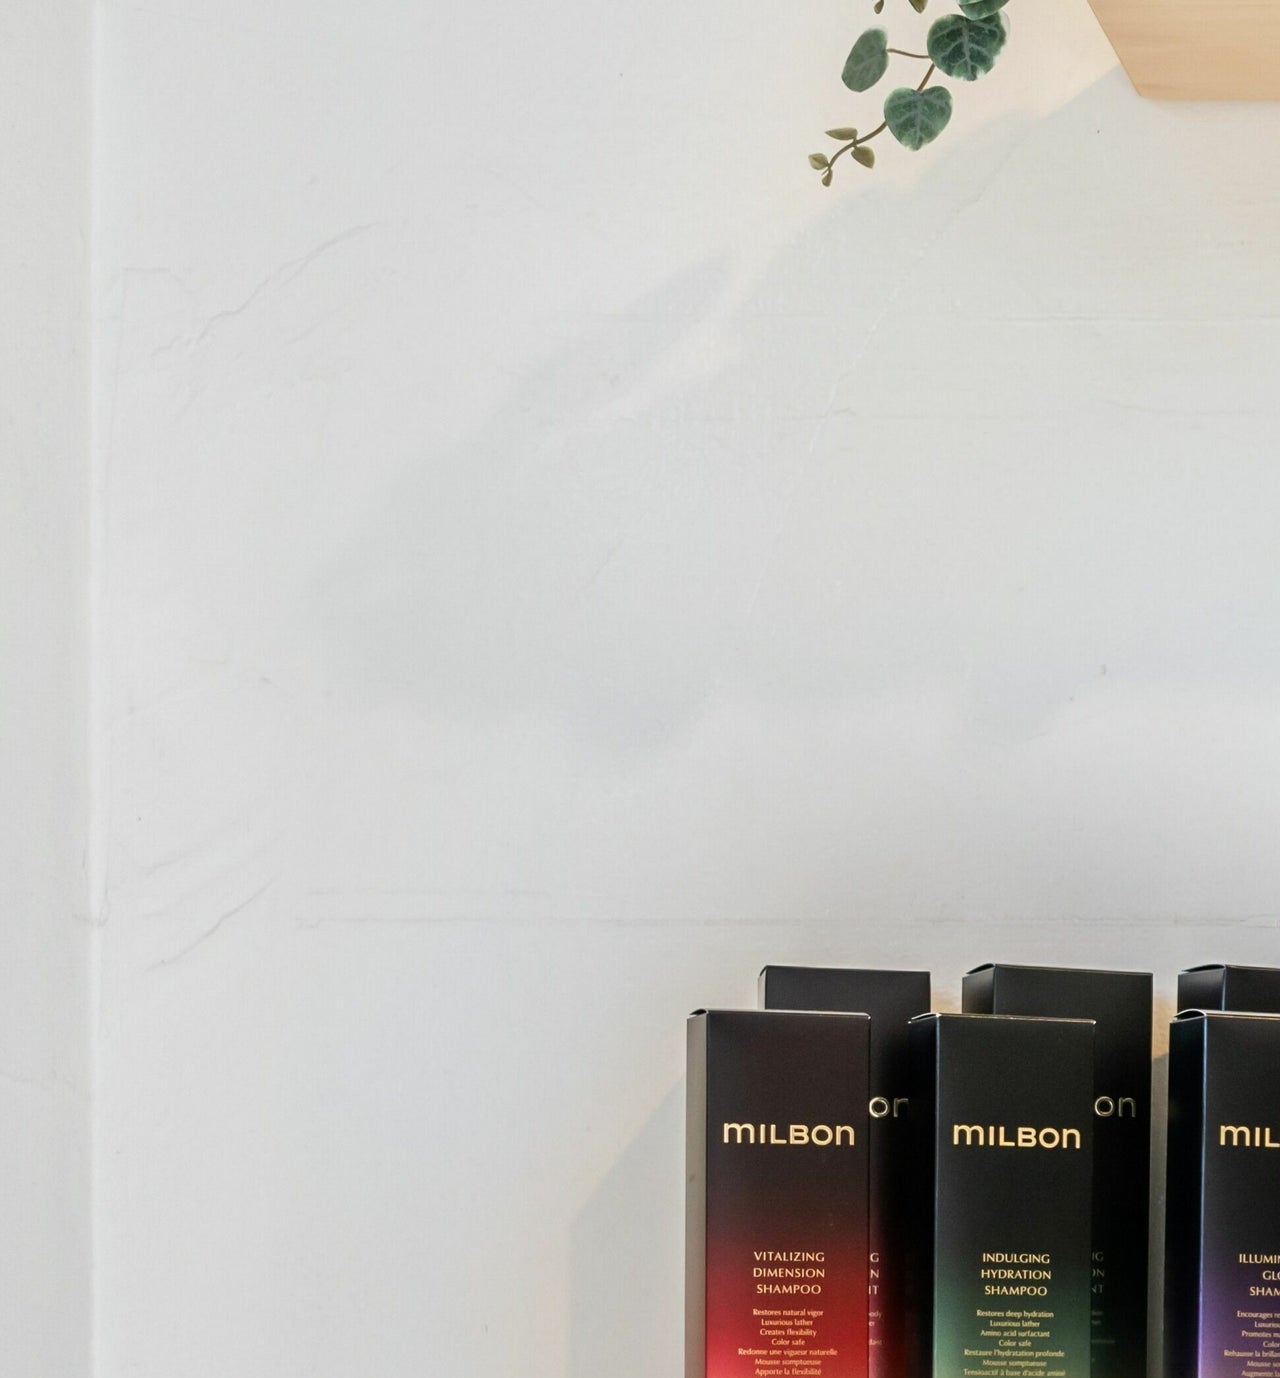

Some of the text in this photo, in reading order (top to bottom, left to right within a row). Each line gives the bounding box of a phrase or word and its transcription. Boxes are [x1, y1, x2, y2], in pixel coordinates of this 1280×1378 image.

[754, 1252, 825, 1262] VITALIZING
[982, 1253, 1050, 1264] INDULGING
[753, 1267, 825, 1278] DIMENSION
[981, 1269, 1051, 1280] HYDRATION
[756, 1284, 822, 1294] SHAMPOO
[984, 1285, 1048, 1296] SHAMPOO
[807, 1310, 824, 1319] vigor
[976, 1309, 1054, 1319] Restores deep hydration
[1022, 1320, 1041, 1328] lather
[786, 1329, 817, 1337] flexibility
[772, 1338, 806, 1346] Color safe
[998, 1339, 1017, 1347] Color
